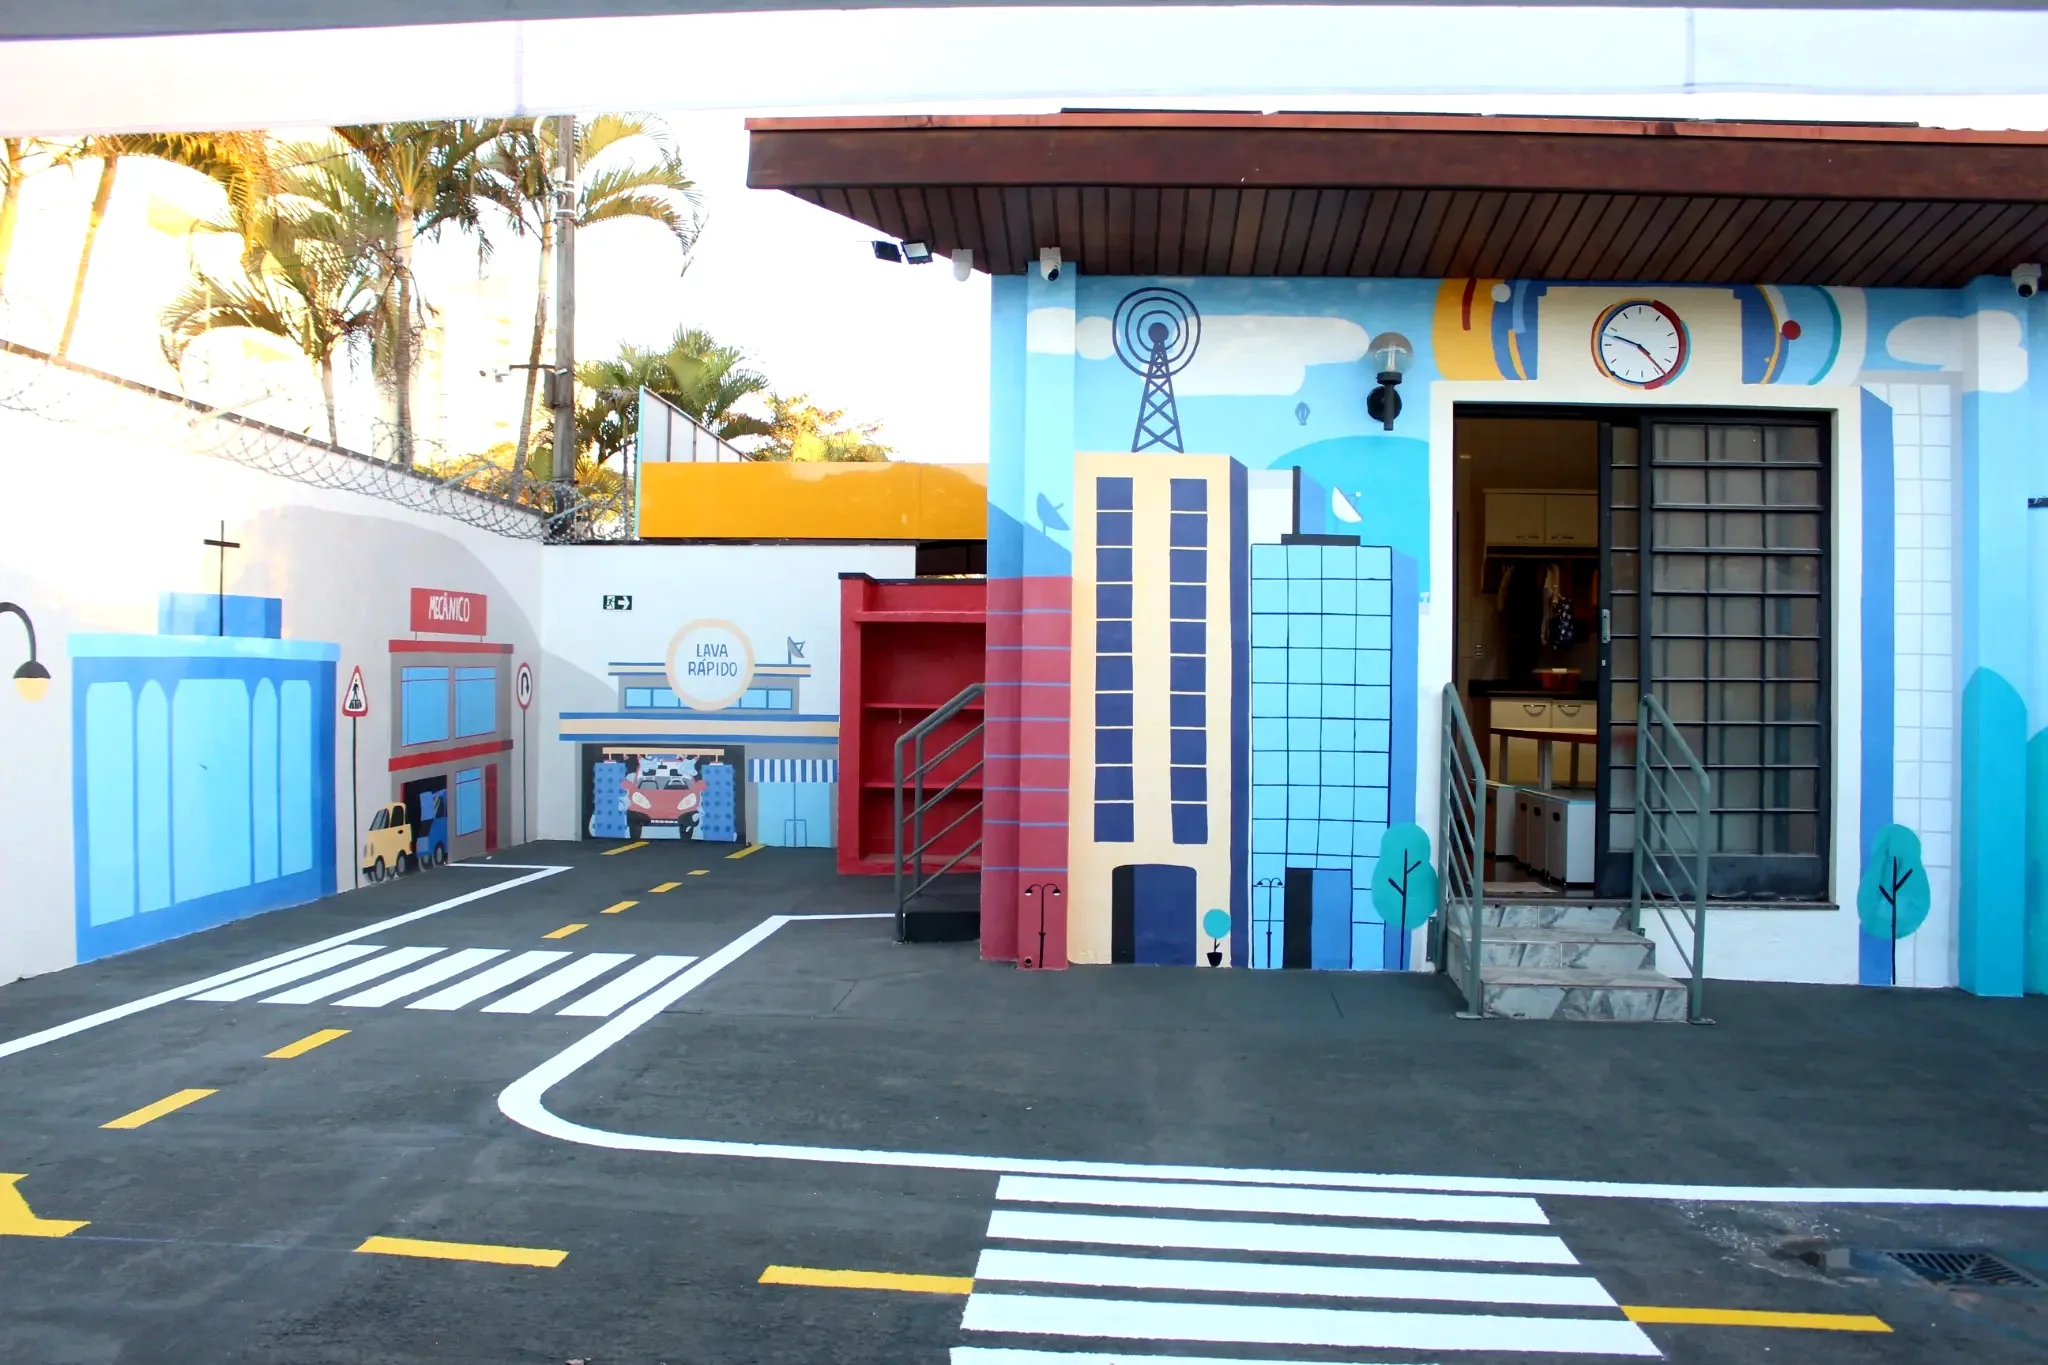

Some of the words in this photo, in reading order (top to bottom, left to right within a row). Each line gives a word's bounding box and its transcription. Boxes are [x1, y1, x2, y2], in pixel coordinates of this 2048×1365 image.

[428, 592, 470, 622] MECÂNICO
[696, 643, 728, 657] LAVA
[688, 658, 737, 676] RÁPIDO
